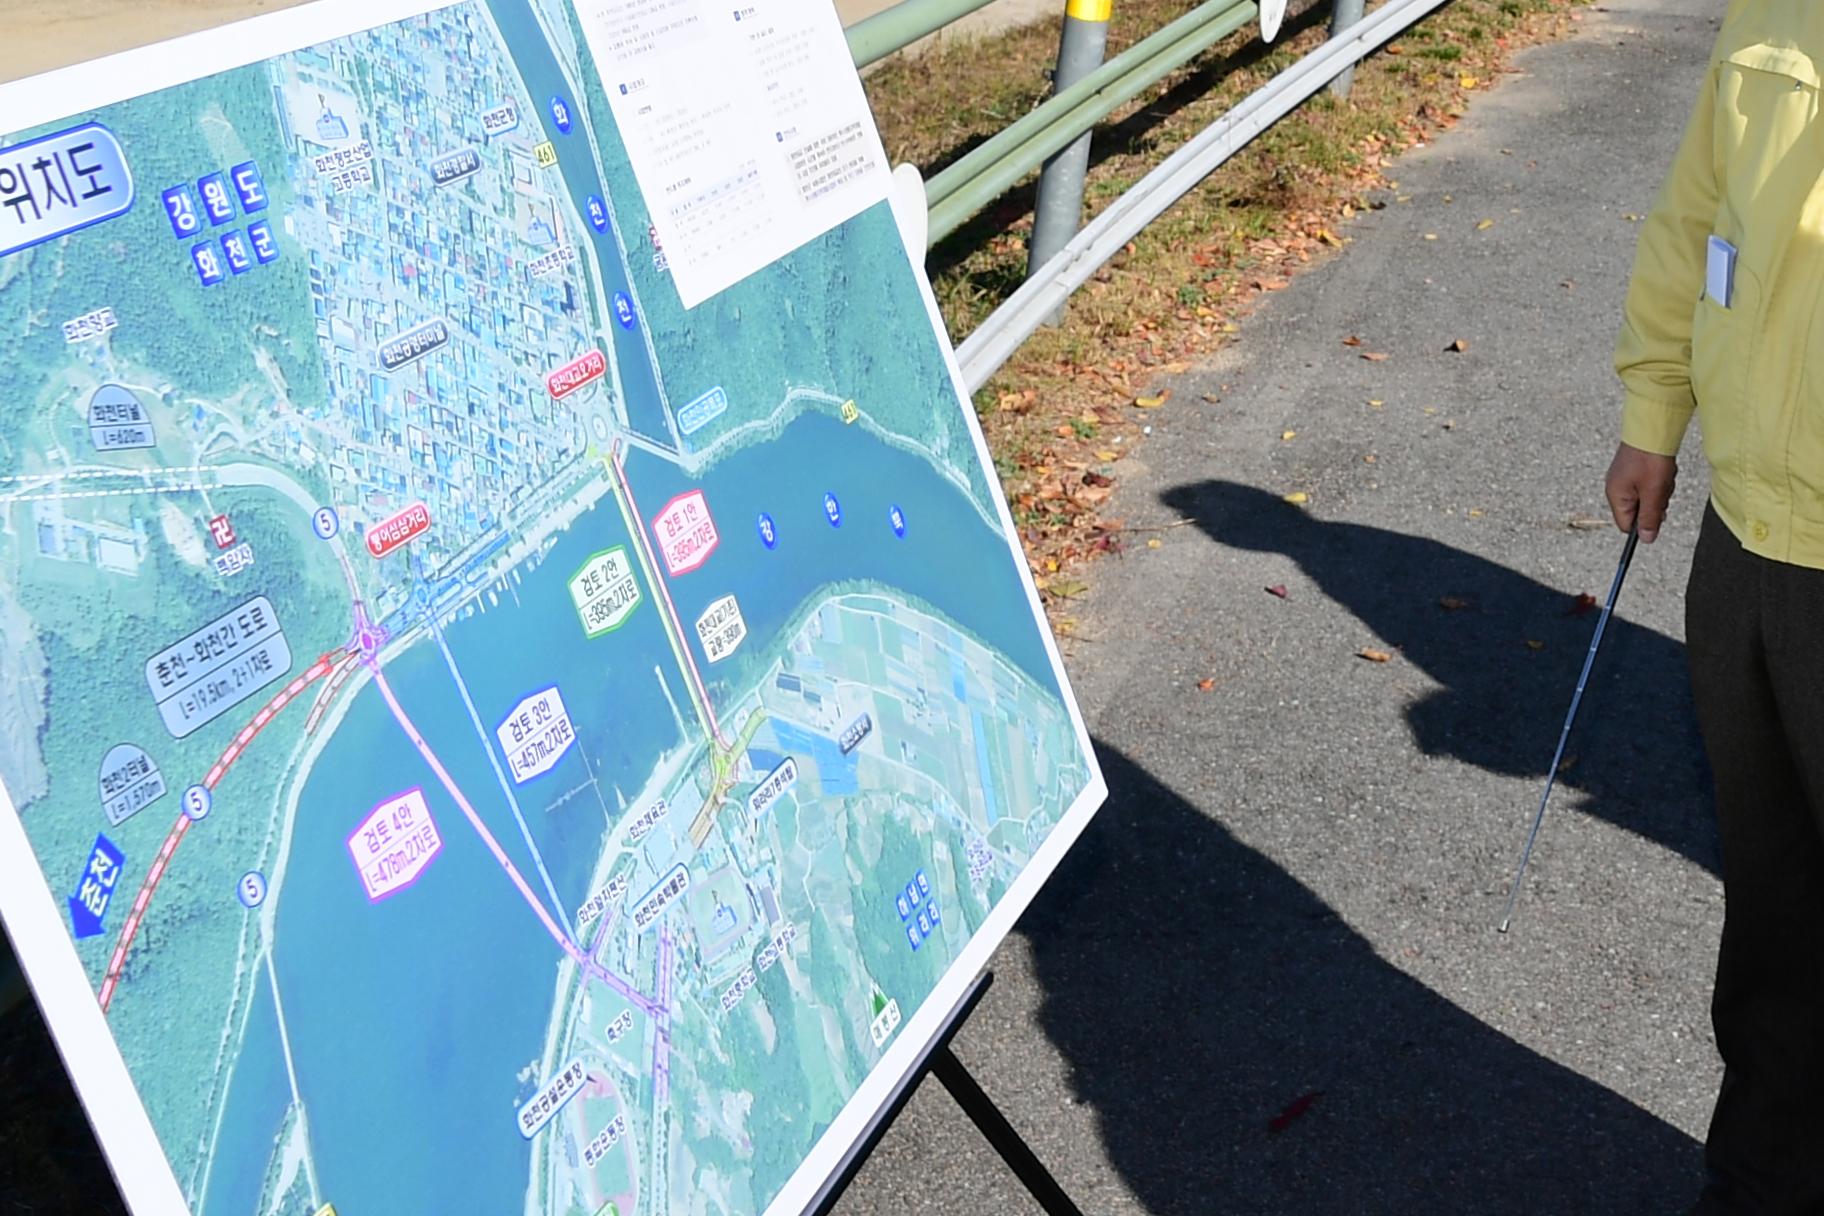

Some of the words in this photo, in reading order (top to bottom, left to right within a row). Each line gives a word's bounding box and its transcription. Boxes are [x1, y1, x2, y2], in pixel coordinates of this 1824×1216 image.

[552, 104, 570, 125] 화
[538, 145, 555, 164] 461
[0, 142, 112, 224] 위치도
[168, 169, 264, 230] 강원도
[589, 201, 605, 225] 천
[197, 227, 275, 279] 화천군
[615, 299, 631, 322] 천
[320, 514, 331, 533] 5
[664, 512, 684, 538] 검토
[683, 502, 698, 525] 1안
[581, 569, 603, 597] 검토
[601, 558, 619, 584] 2안
[154, 622, 237, 688] 춘천~화천간
[238, 606, 268, 640] 도로
[508, 712, 534, 743] 검토
[532, 697, 553, 726] 3안
[100, 755, 150, 794] 화천2터널
[190, 792, 202, 812] 5
[363, 819, 392, 854] 검토
[392, 803, 415, 832] 4안
[246, 878, 258, 898] 5
